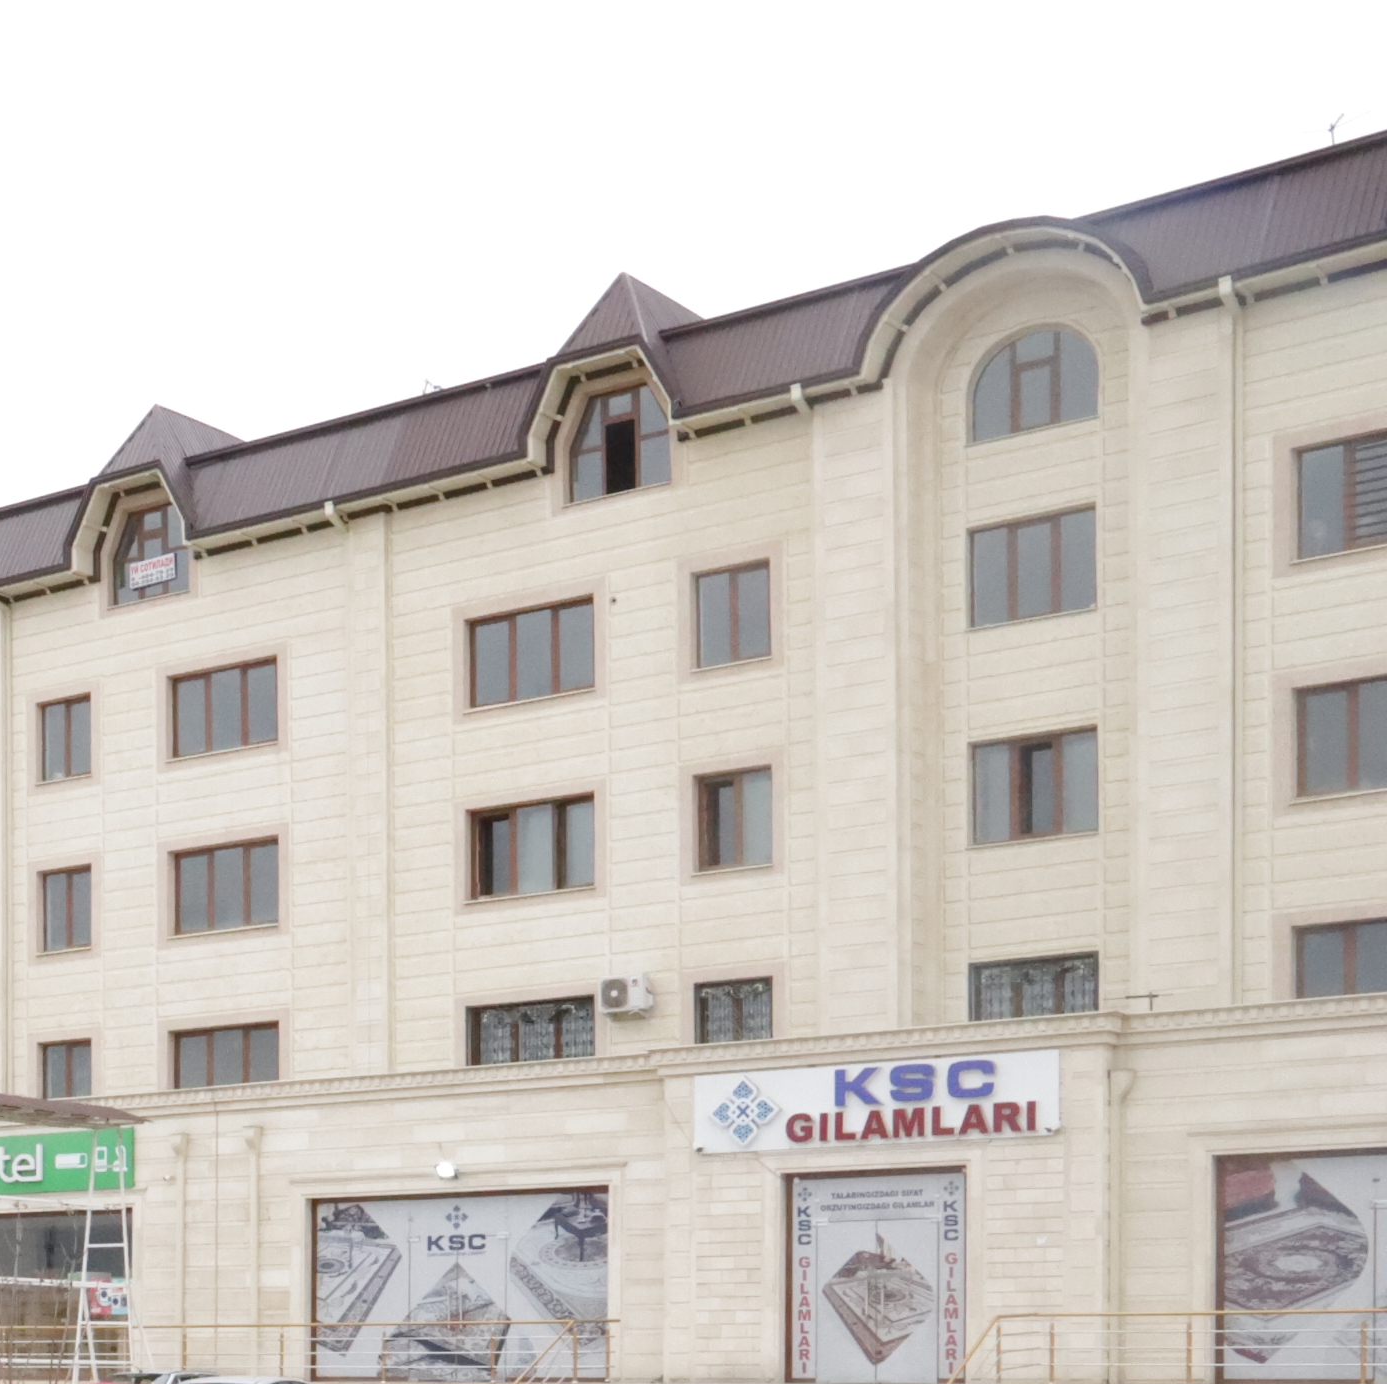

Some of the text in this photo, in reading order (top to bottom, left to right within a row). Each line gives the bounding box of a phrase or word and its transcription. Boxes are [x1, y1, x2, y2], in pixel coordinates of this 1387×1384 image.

[833, 1060, 997, 1107] KSC
[785, 1101, 1038, 1143] GILAMLARI
[797, 1206, 812, 1246] KSC
[943, 1200, 959, 1241] KSC
[427, 1234, 486, 1251] KSC
[798, 1256, 811, 1375] GILAMLARI
[944, 1252, 958, 1375] GILAMLARI
